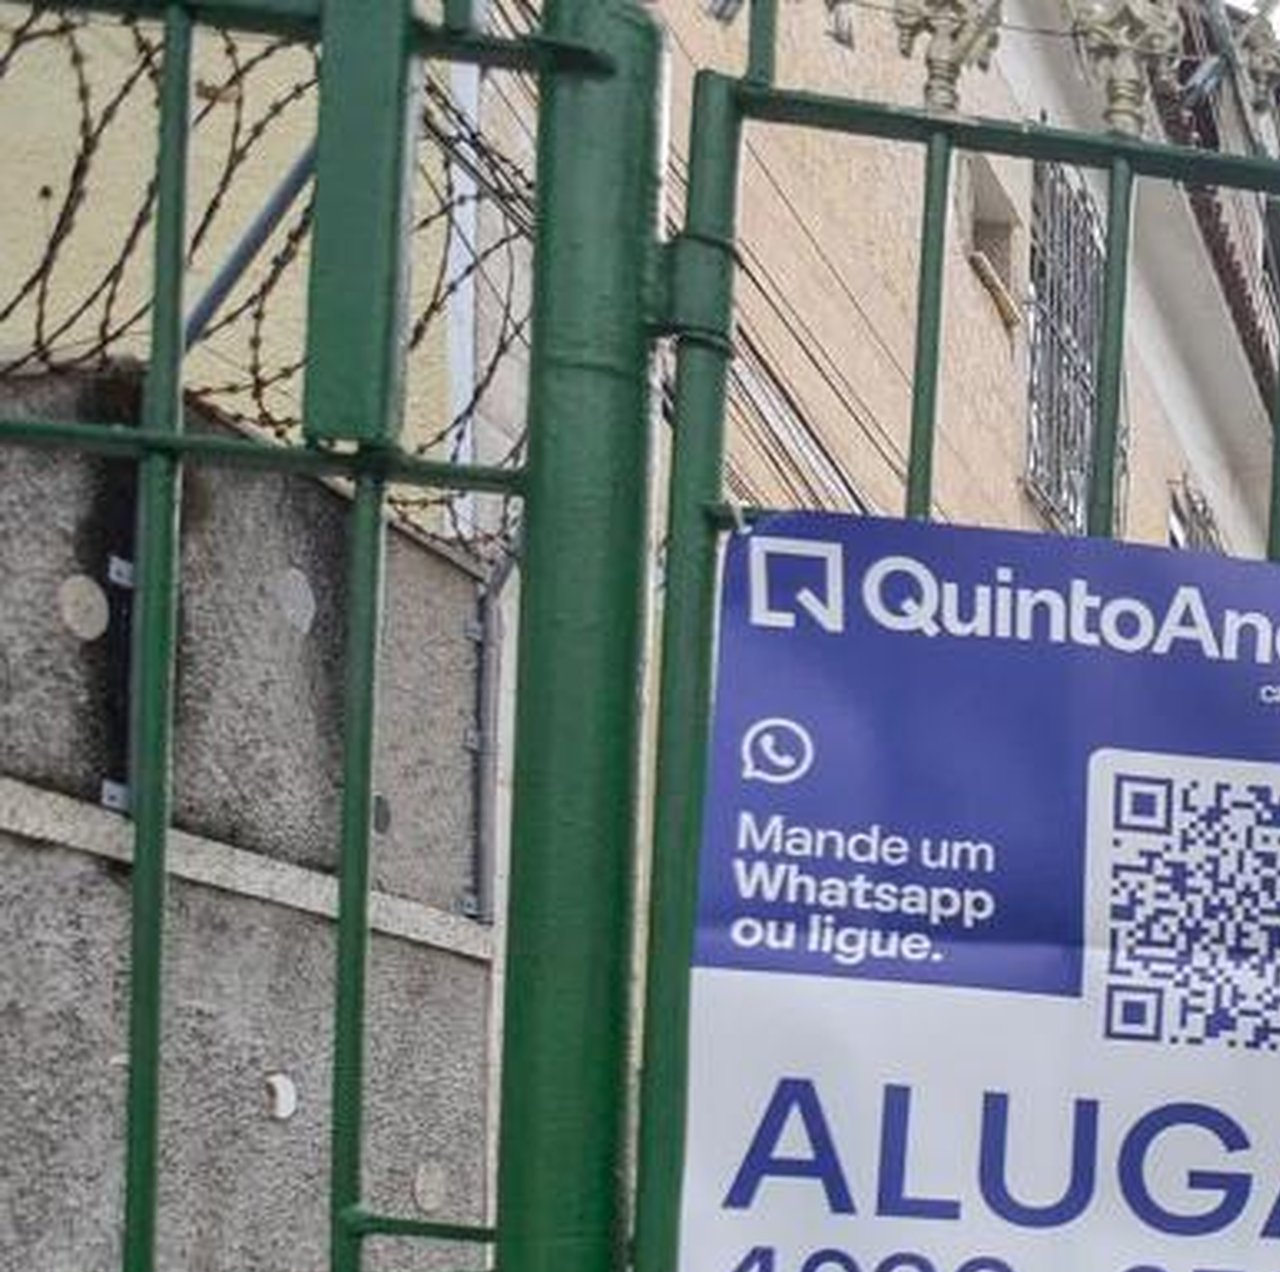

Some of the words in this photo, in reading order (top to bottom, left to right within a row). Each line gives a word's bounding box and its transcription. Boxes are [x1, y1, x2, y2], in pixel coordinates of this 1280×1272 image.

[737, 811, 909, 865] Mande
[918, 837, 996, 872] um
[735, 860, 995, 927] Whatsapp
[731, 915, 796, 951] ou
[806, 911, 944, 966] ligue.
